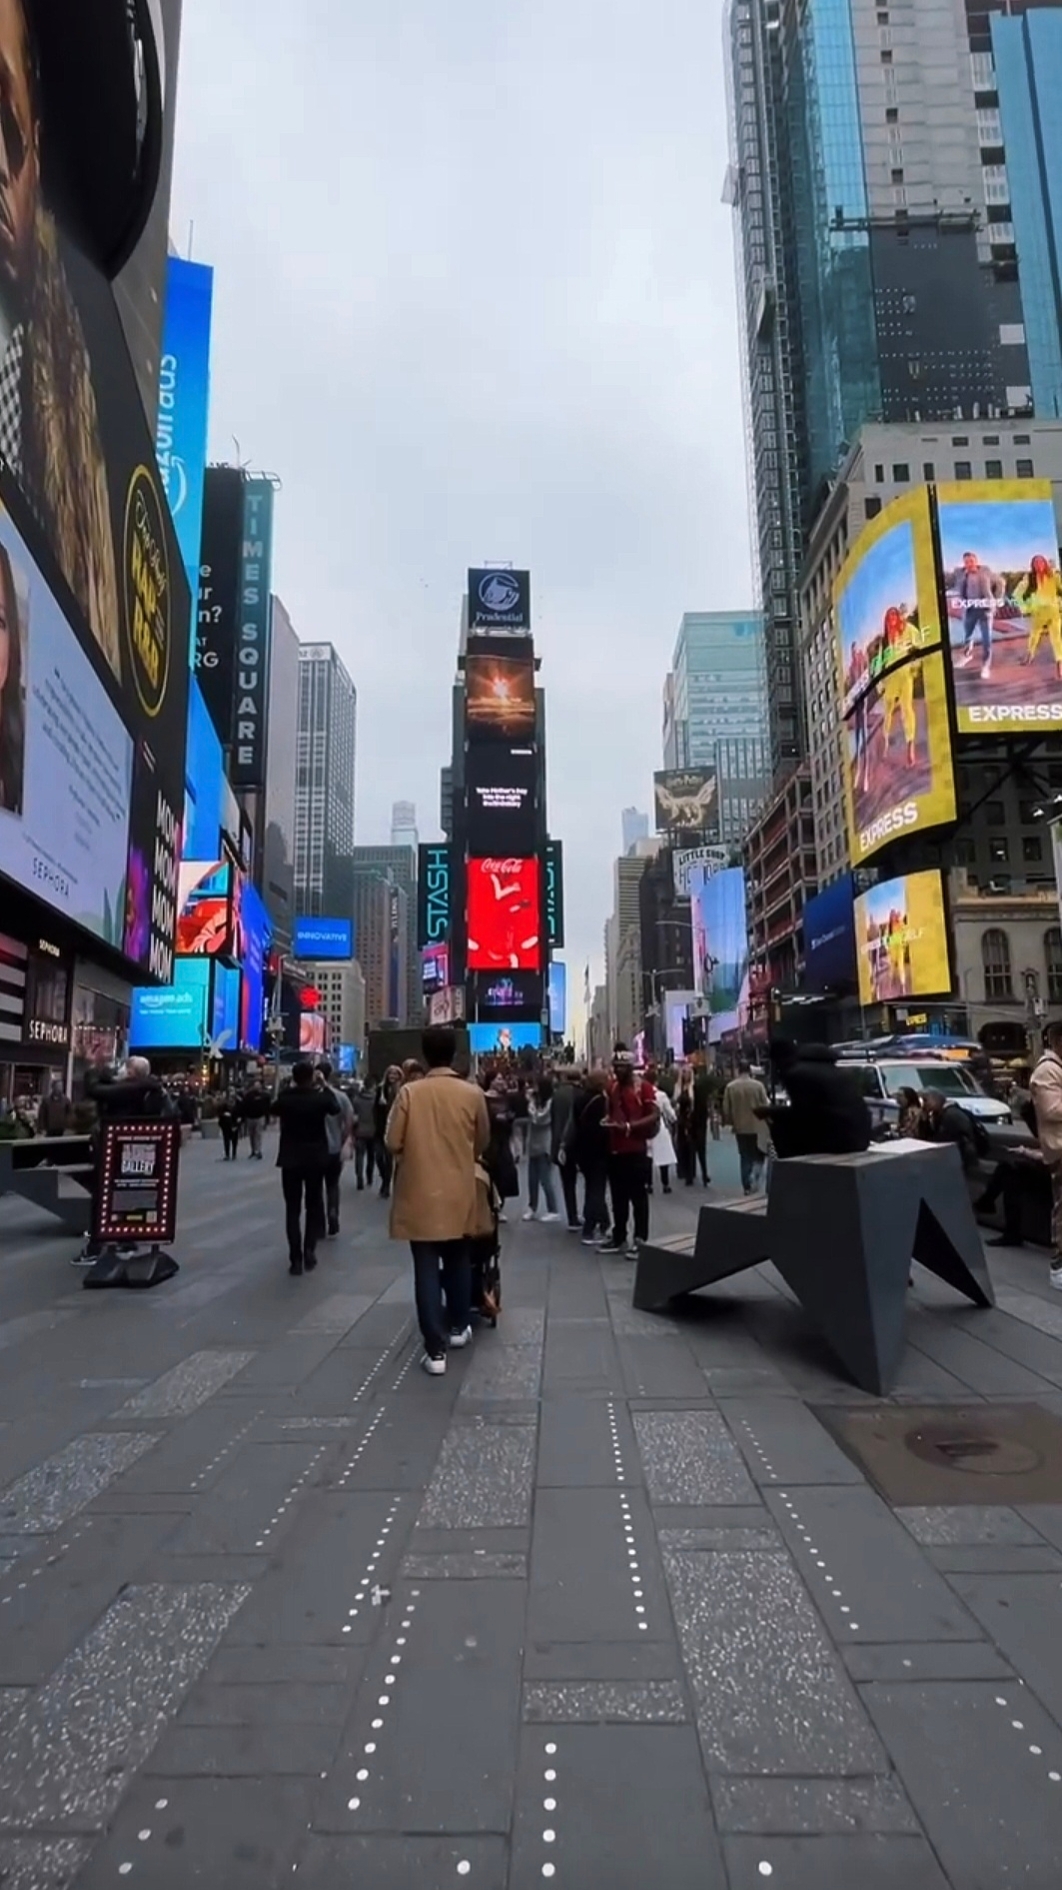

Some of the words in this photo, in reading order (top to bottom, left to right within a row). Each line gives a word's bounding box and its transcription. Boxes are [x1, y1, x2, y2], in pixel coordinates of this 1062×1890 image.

[242, 494, 264, 605] TIMES
[475, 611, 523, 622] Prudential
[237, 623, 260, 765] SQUARE
[968, 703, 1062, 722] EXPRESS
[156, 788, 179, 850] MOM
[859, 800, 919, 853] EXPRESS
[32, 856, 70, 899] SEPHORA
[154, 836, 177, 897] MOM
[679, 848, 704, 866] LITTLE
[152, 884, 175, 940] MOM
[427, 849, 448, 938] STASH
[39, 939, 60, 957] SEPHORA
[149, 932, 172, 984] MOM
[29, 1019, 68, 1043] SEPHORA
